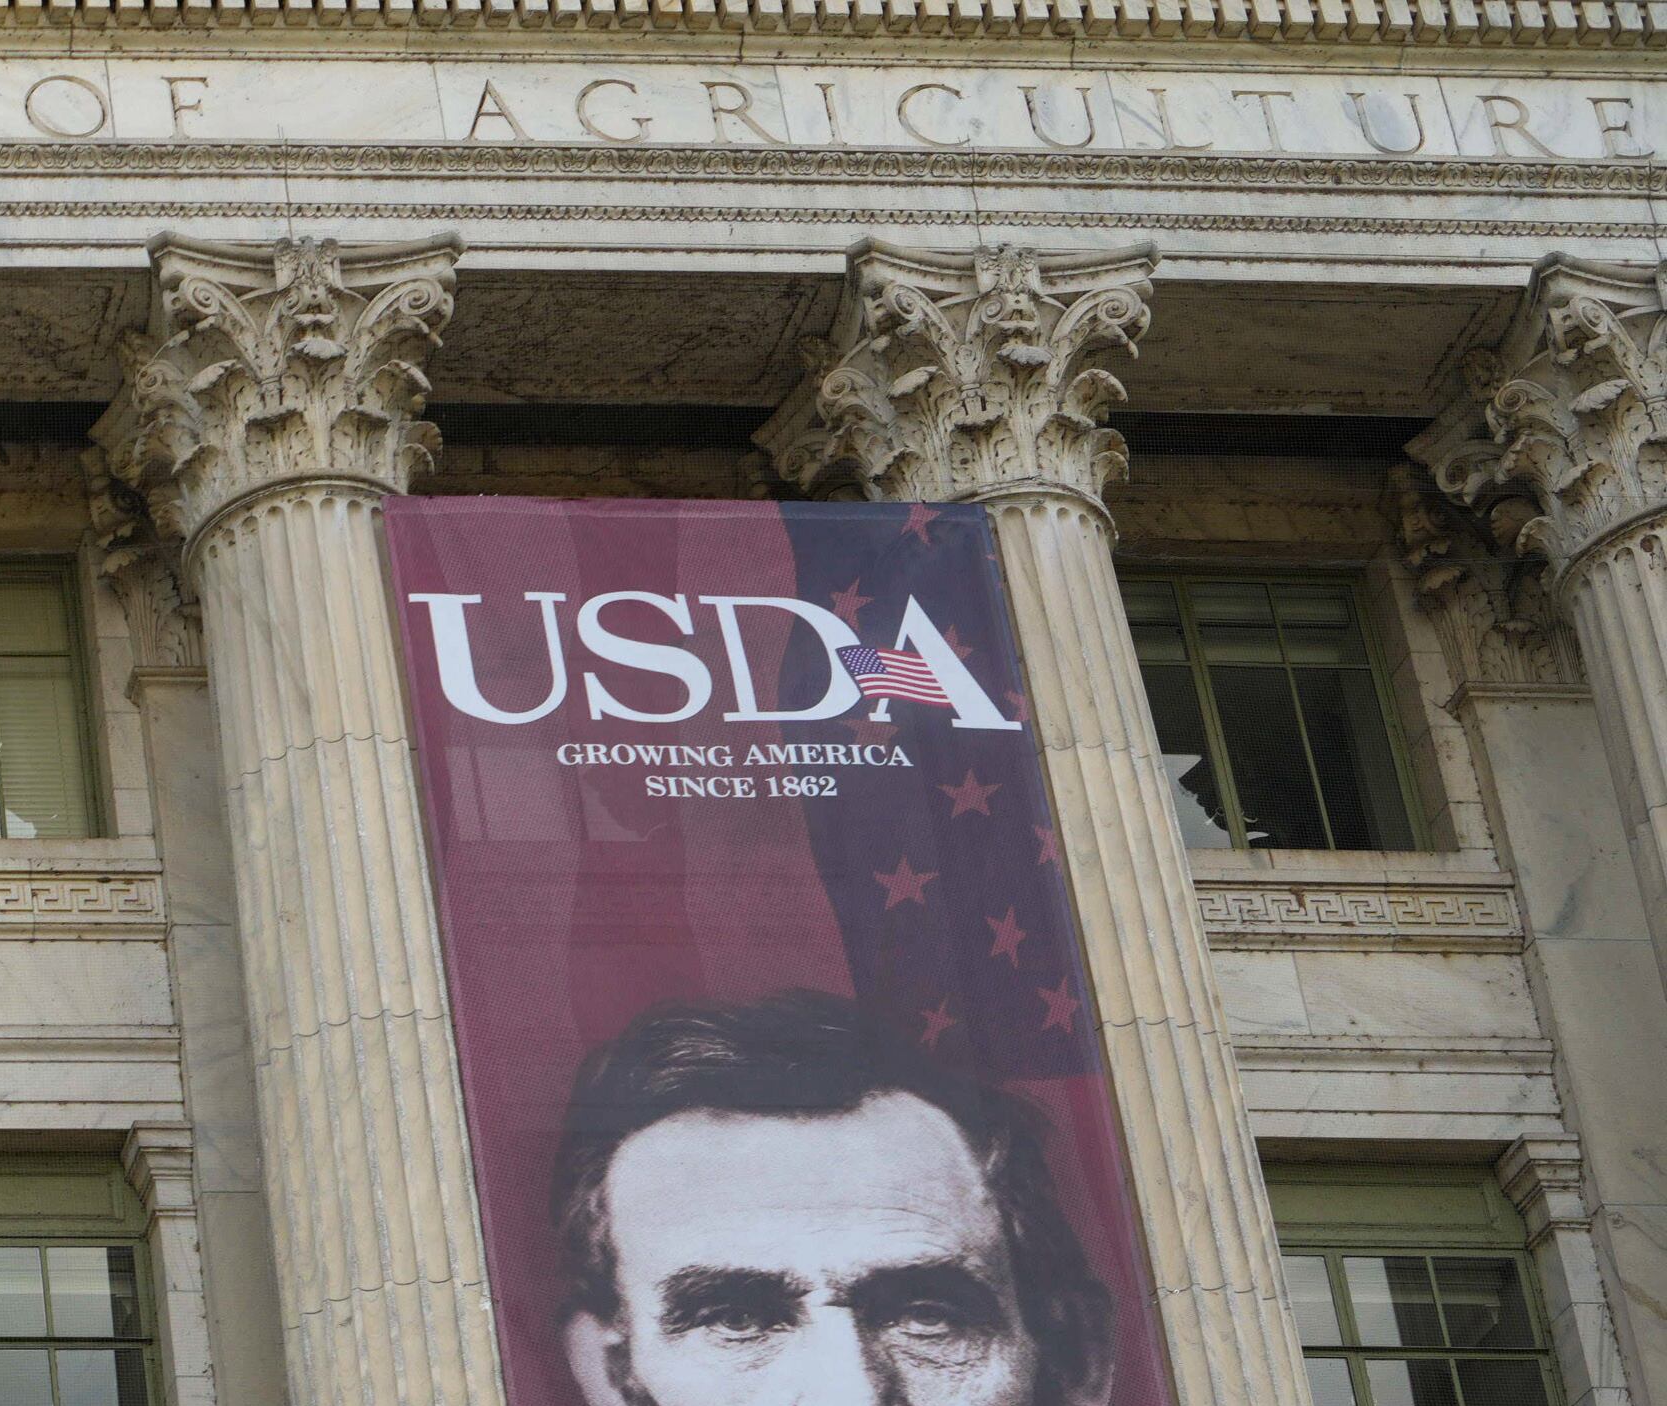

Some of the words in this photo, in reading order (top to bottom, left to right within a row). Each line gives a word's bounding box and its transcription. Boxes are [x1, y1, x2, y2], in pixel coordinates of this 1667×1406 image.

[23, 74, 209, 141] OF
[466, 78, 1656, 160] AGRICULTURE
[408, 590, 1023, 732] USDA
[555, 743, 734, 769] GROWING
[743, 743, 914, 768] AMERICA
[645, 776, 757, 800] SINCE
[766, 775, 839, 799] 1862
